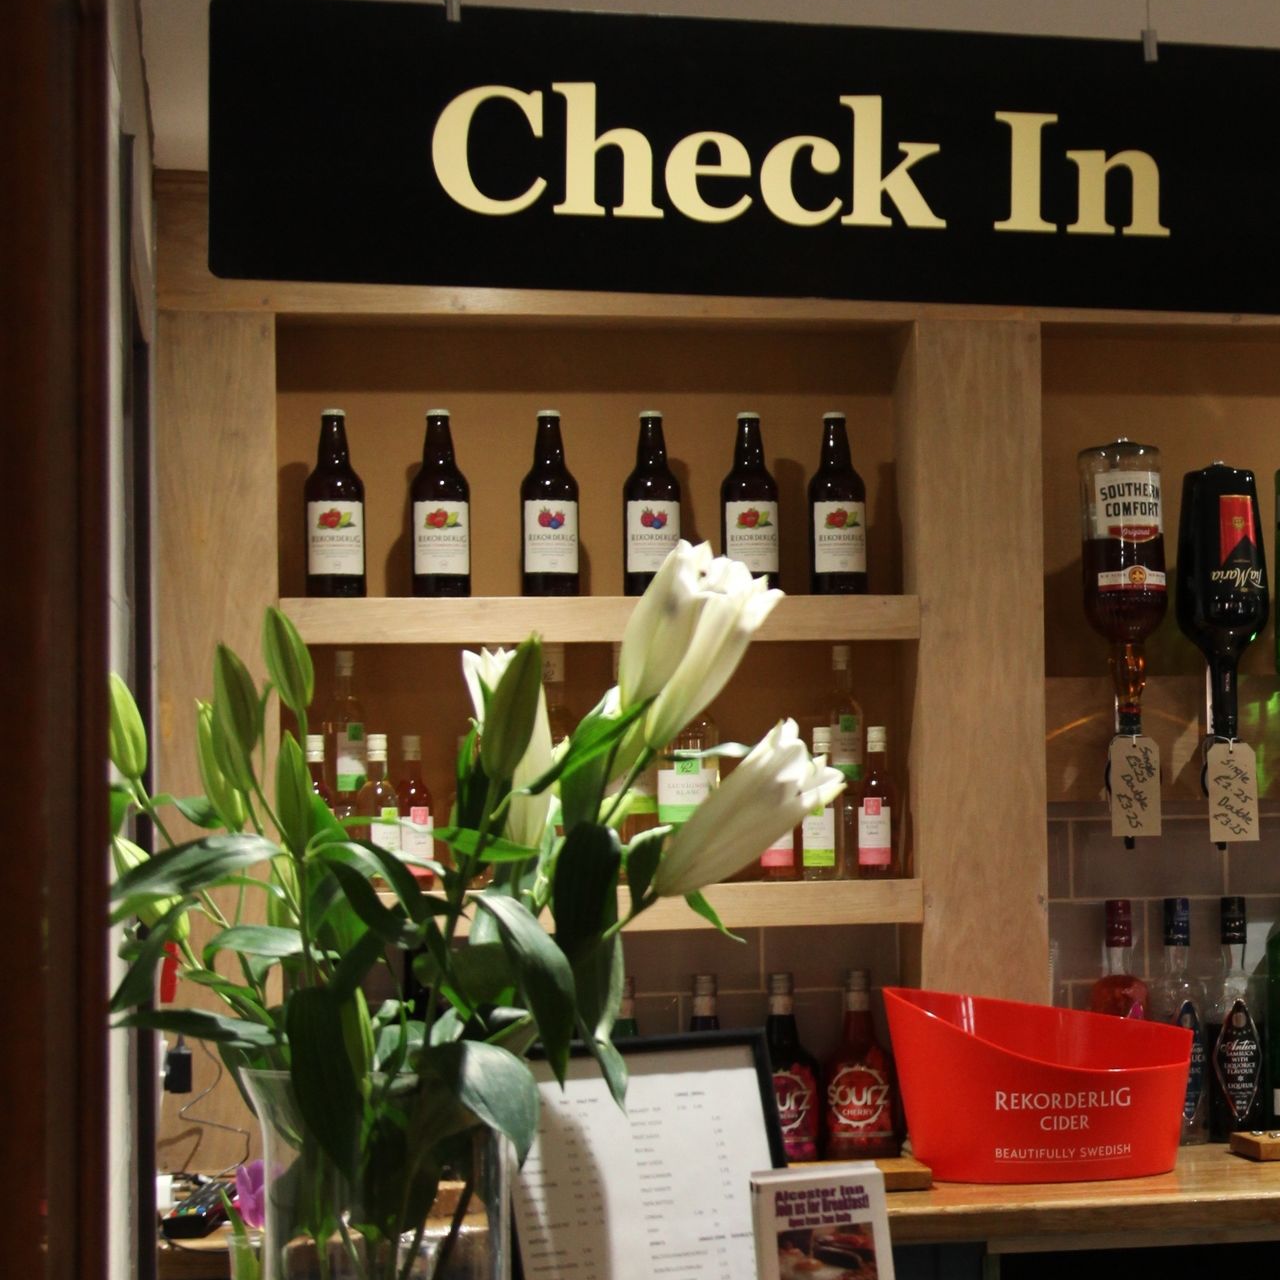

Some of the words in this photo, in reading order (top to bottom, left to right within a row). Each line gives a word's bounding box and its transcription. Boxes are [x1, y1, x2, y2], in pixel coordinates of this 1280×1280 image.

[431, 81, 947, 229] Check
[993, 111, 1172, 237] In
[1100, 482, 1160, 501] SOUTHERN
[1105, 501, 1159, 517] COMFORT
[1211, 567, 1251, 588] Maria
[1220, 759, 1250, 785] Single
[1218, 796, 1253, 825] Double
[995, 1087, 1131, 1111] REKORDERLIG
[1040, 1114, 1090, 1132] CIDER
[995, 1147, 1076, 1160] BEAUTIFULLY
[1079, 1143, 1131, 1158] SWEDISH
